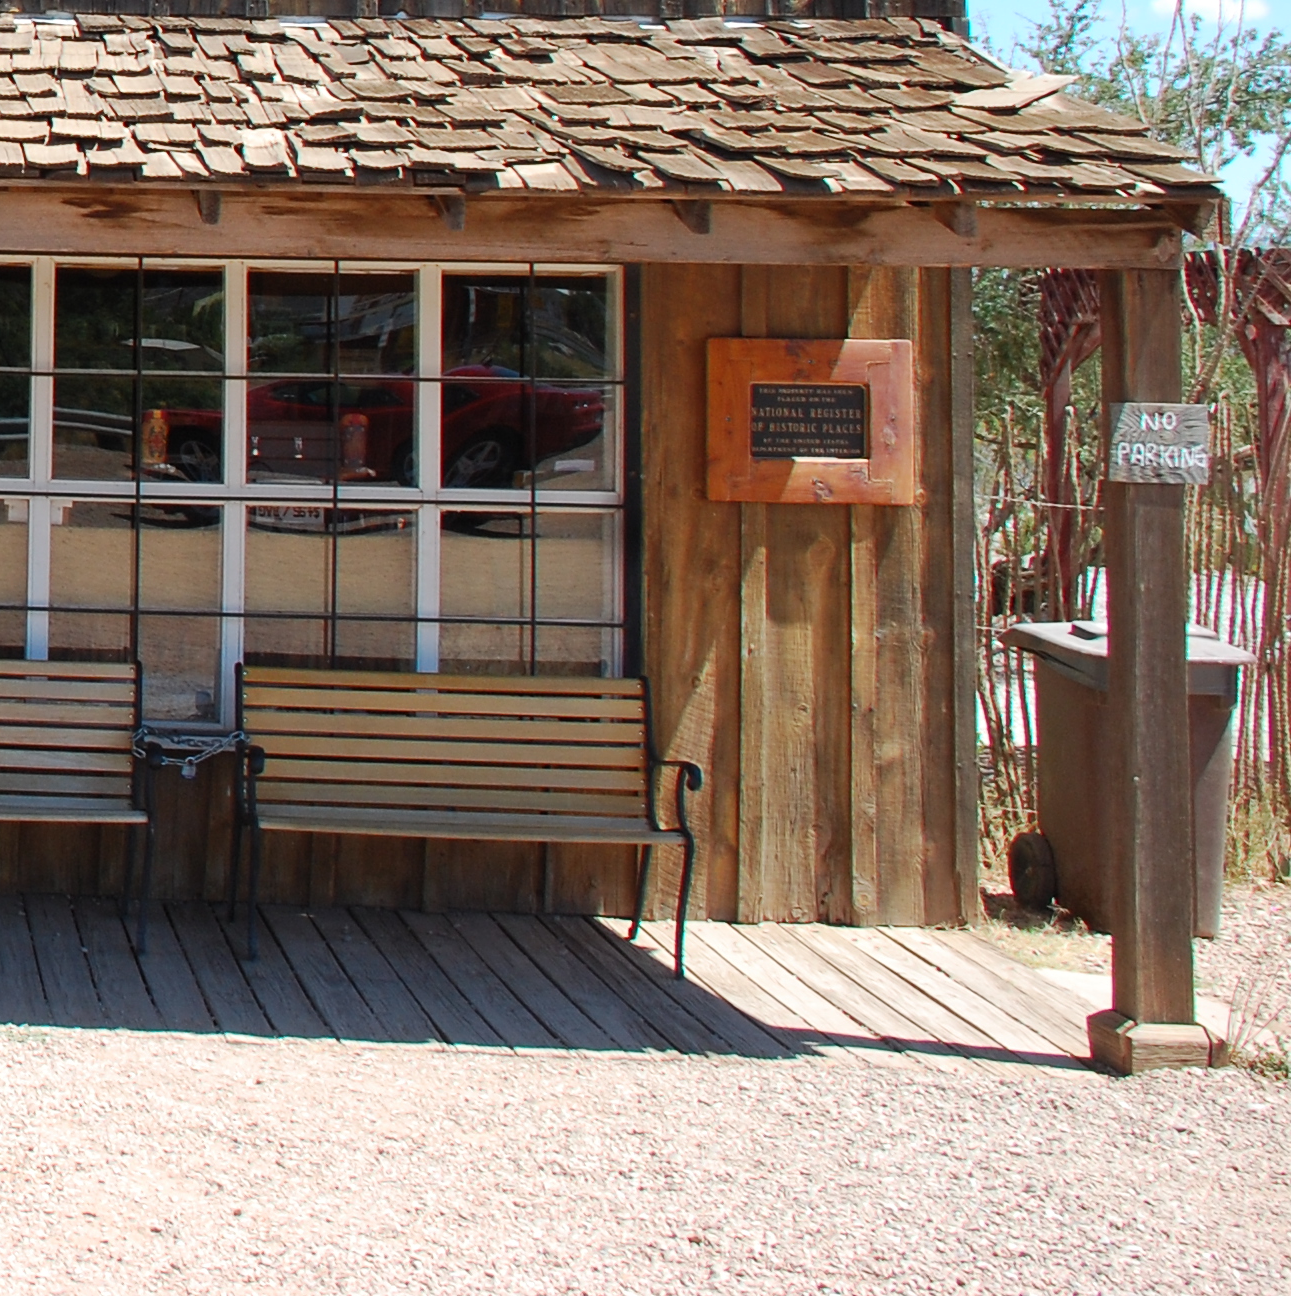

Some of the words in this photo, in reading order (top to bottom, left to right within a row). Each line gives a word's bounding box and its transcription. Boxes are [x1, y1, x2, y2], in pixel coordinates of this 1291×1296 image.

[751, 406, 805, 418] NATIONAL
[809, 408, 862, 419] REGISTER
[751, 422, 763, 432] OF
[769, 422, 818, 433] HISTORIC
[822, 423, 862, 434] PLACES
[1140, 411, 1177, 432] NO
[1117, 441, 1207, 468] PARKING
